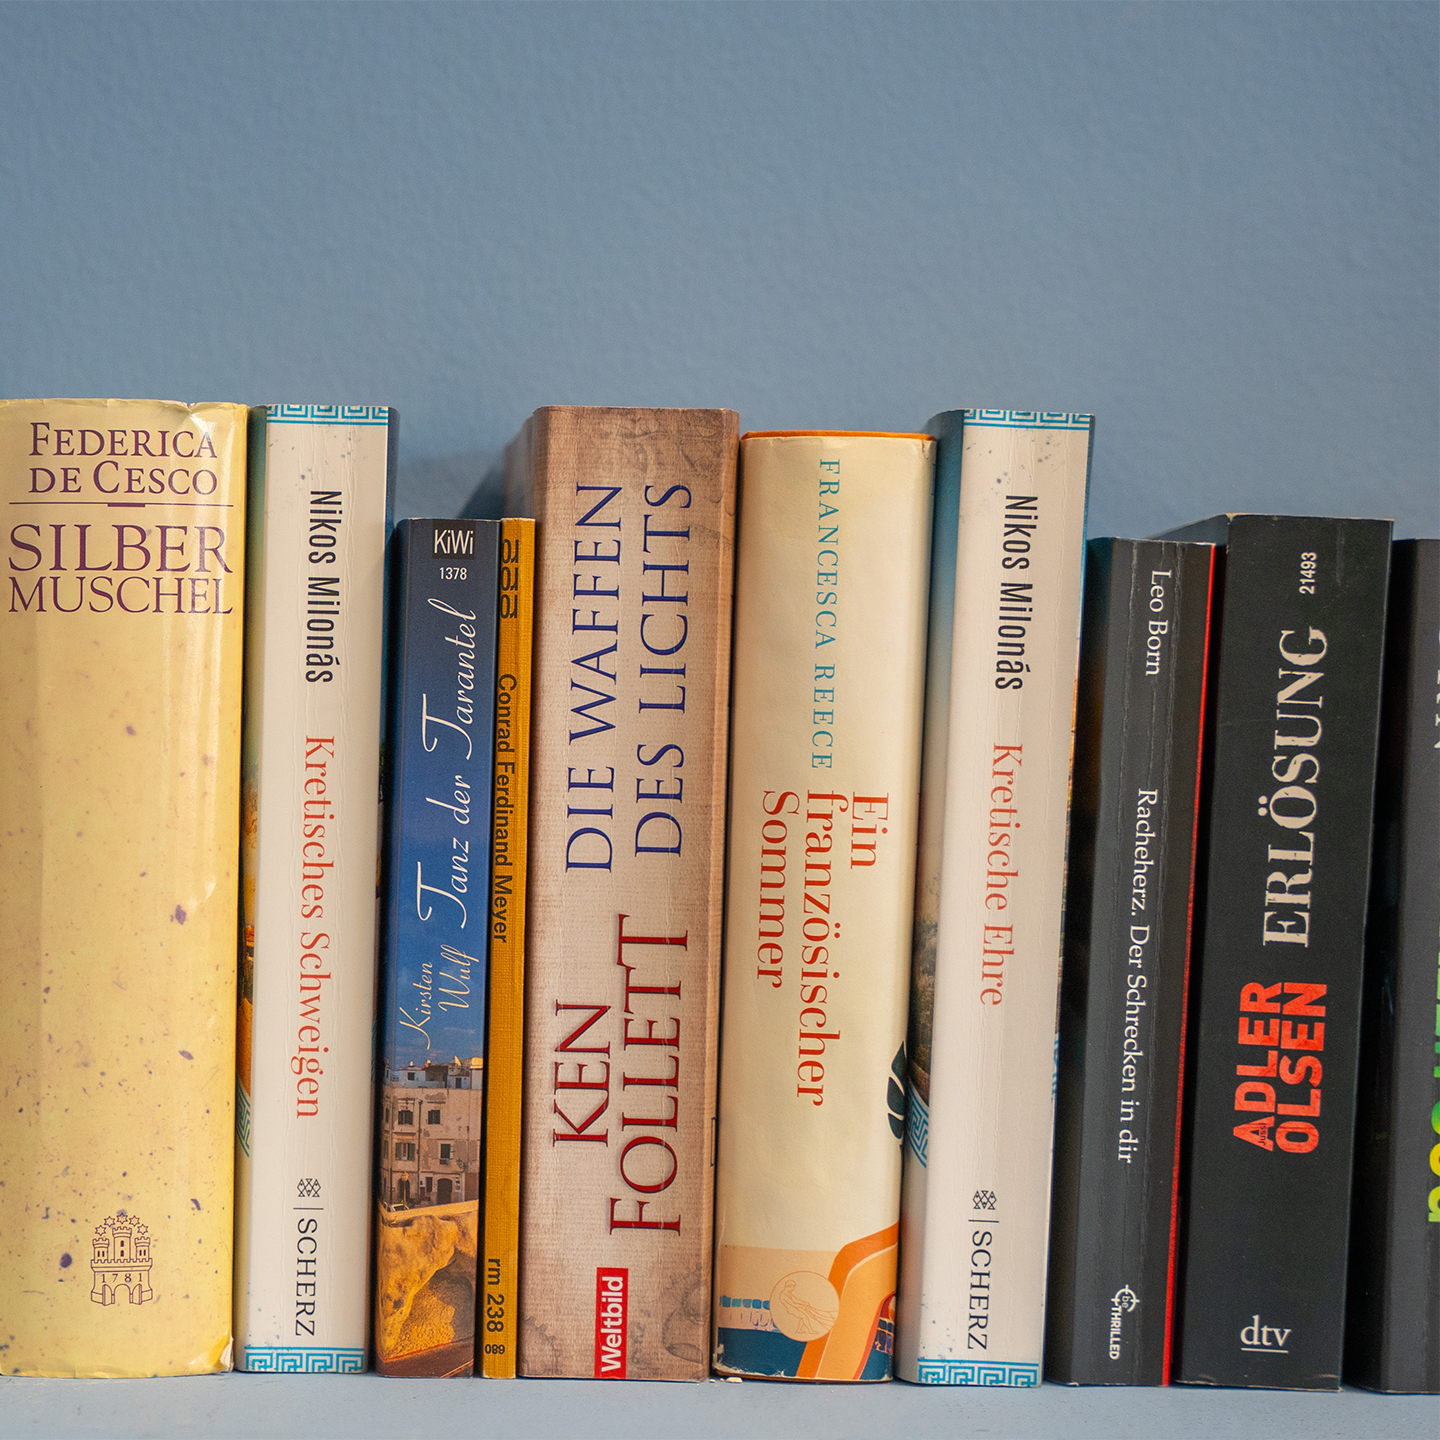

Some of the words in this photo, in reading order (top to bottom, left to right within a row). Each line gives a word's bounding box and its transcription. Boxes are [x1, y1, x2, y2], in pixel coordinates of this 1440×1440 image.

[28, 467, 82, 494] DE
[93, 461, 217, 495] CESCO
[29, 422, 217, 458] FEDERICA
[9, 524, 233, 573] SILBER
[308, 490, 342, 564] Nikos
[434, 530, 473, 554] KiWi
[815, 459, 841, 649] FRANCESCA
[1001, 495, 1038, 569] Nikos
[8, 576, 233, 614] MUSCHEL
[439, 567, 467, 580] 1378
[569, 482, 623, 745] WAFFEN
[639, 484, 691, 714] LICHTS
[1149, 570, 1171, 613] Leo
[1299, 552, 1317, 595] 21493
[305, 576, 341, 683] Milonás
[995, 582, 1033, 690] Milonás
[1146, 620, 1168, 676] Born
[423, 598, 477, 760] Tarantel
[497, 673, 517, 753] Conrad
[812, 663, 835, 769] REECE
[301, 735, 335, 919] Kretisches
[426, 775, 471, 825] der
[495, 761, 514, 867] Ferdinand
[565, 765, 614, 873] DIE
[634, 743, 684, 857] DES
[985, 743, 1022, 911] Kretische
[1258, 626, 1328, 948] ERLÖSUNG
[851, 792, 889, 869] Ein
[1131, 788, 1157, 916] Racheherz.
[416, 837, 469, 929] Tanz
[493, 875, 513, 943] Meyer
[757, 790, 800, 989] Sommer
[438, 944, 479, 1013] Wulf
[796, 790, 849, 1106] französischer
[980, 924, 1015, 1006] Ehre
[1128, 925, 1150, 968] Der
[291, 931, 331, 1119] Schweigen
[399, 962, 433, 1050] Kirsten
[1122, 974, 1147, 1093] Schrecken
[553, 999, 611, 1147] KEN
[610, 913, 689, 1236] FOLLETT
[1233, 982, 1283, 1151] ADLER
[1275, 982, 1327, 1154] OLSEN
[1118, 1129, 1139, 1163] dir
[1120, 1099, 1140, 1122] in
[1258, 1122, 1268, 1146] Jussi
[102, 1273, 142, 1283] 1781
[295, 1218, 318, 1336] SCHERZ
[487, 1294, 504, 1332] 238
[488, 1259, 500, 1286] rm
[967, 1230, 992, 1350] SCHERZ
[1121, 1295, 1131, 1309] be
[485, 1344, 505, 1354] 680
[601, 1275, 623, 1372] Weltbild
[1109, 1306, 1121, 1360] THRILLED
[1240, 1315, 1291, 1348] dtv
